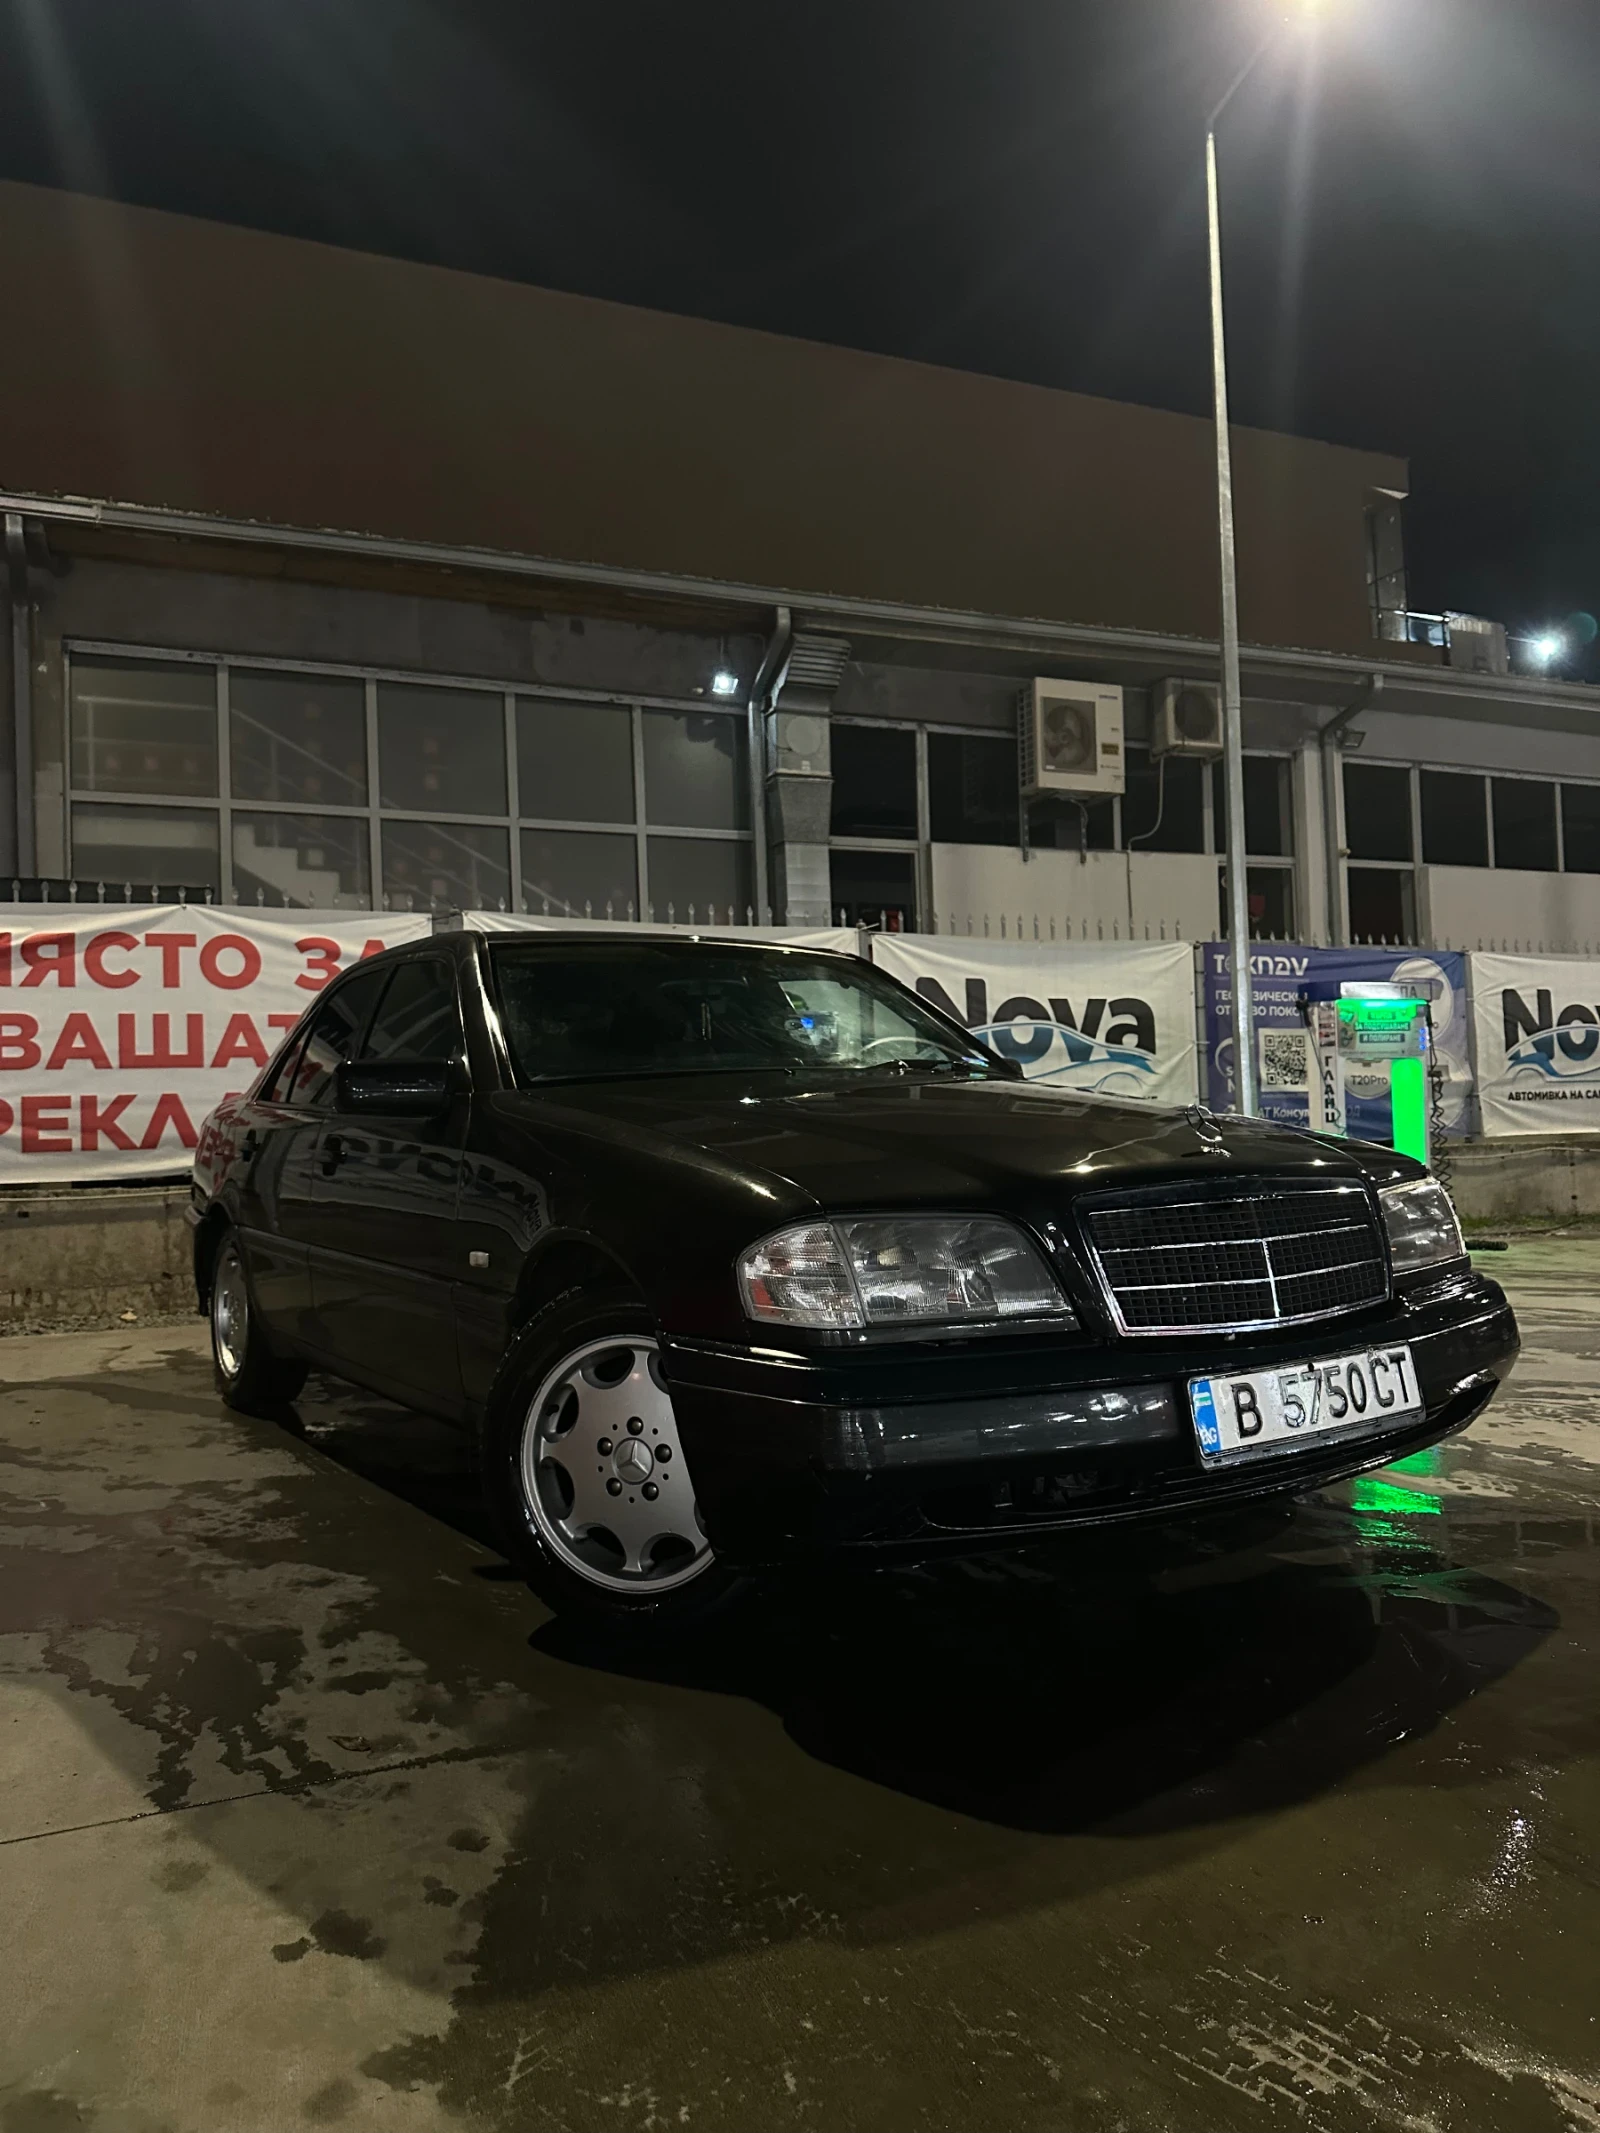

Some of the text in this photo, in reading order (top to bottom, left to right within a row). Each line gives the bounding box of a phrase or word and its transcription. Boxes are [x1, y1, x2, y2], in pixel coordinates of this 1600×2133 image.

[0, 931, 262, 991] ЯСТО
[915, 977, 1157, 1065] Nova
[1269, 1006, 1300, 1017] ПОКО
[1502, 988, 1600, 1062] No
[1324, 1055, 1335, 1123] ГЛАНЦ
[1350, 1074, 1388, 1086] T20Pro
[1508, 1089, 1600, 1102] АВТОМИВКА НА СА
